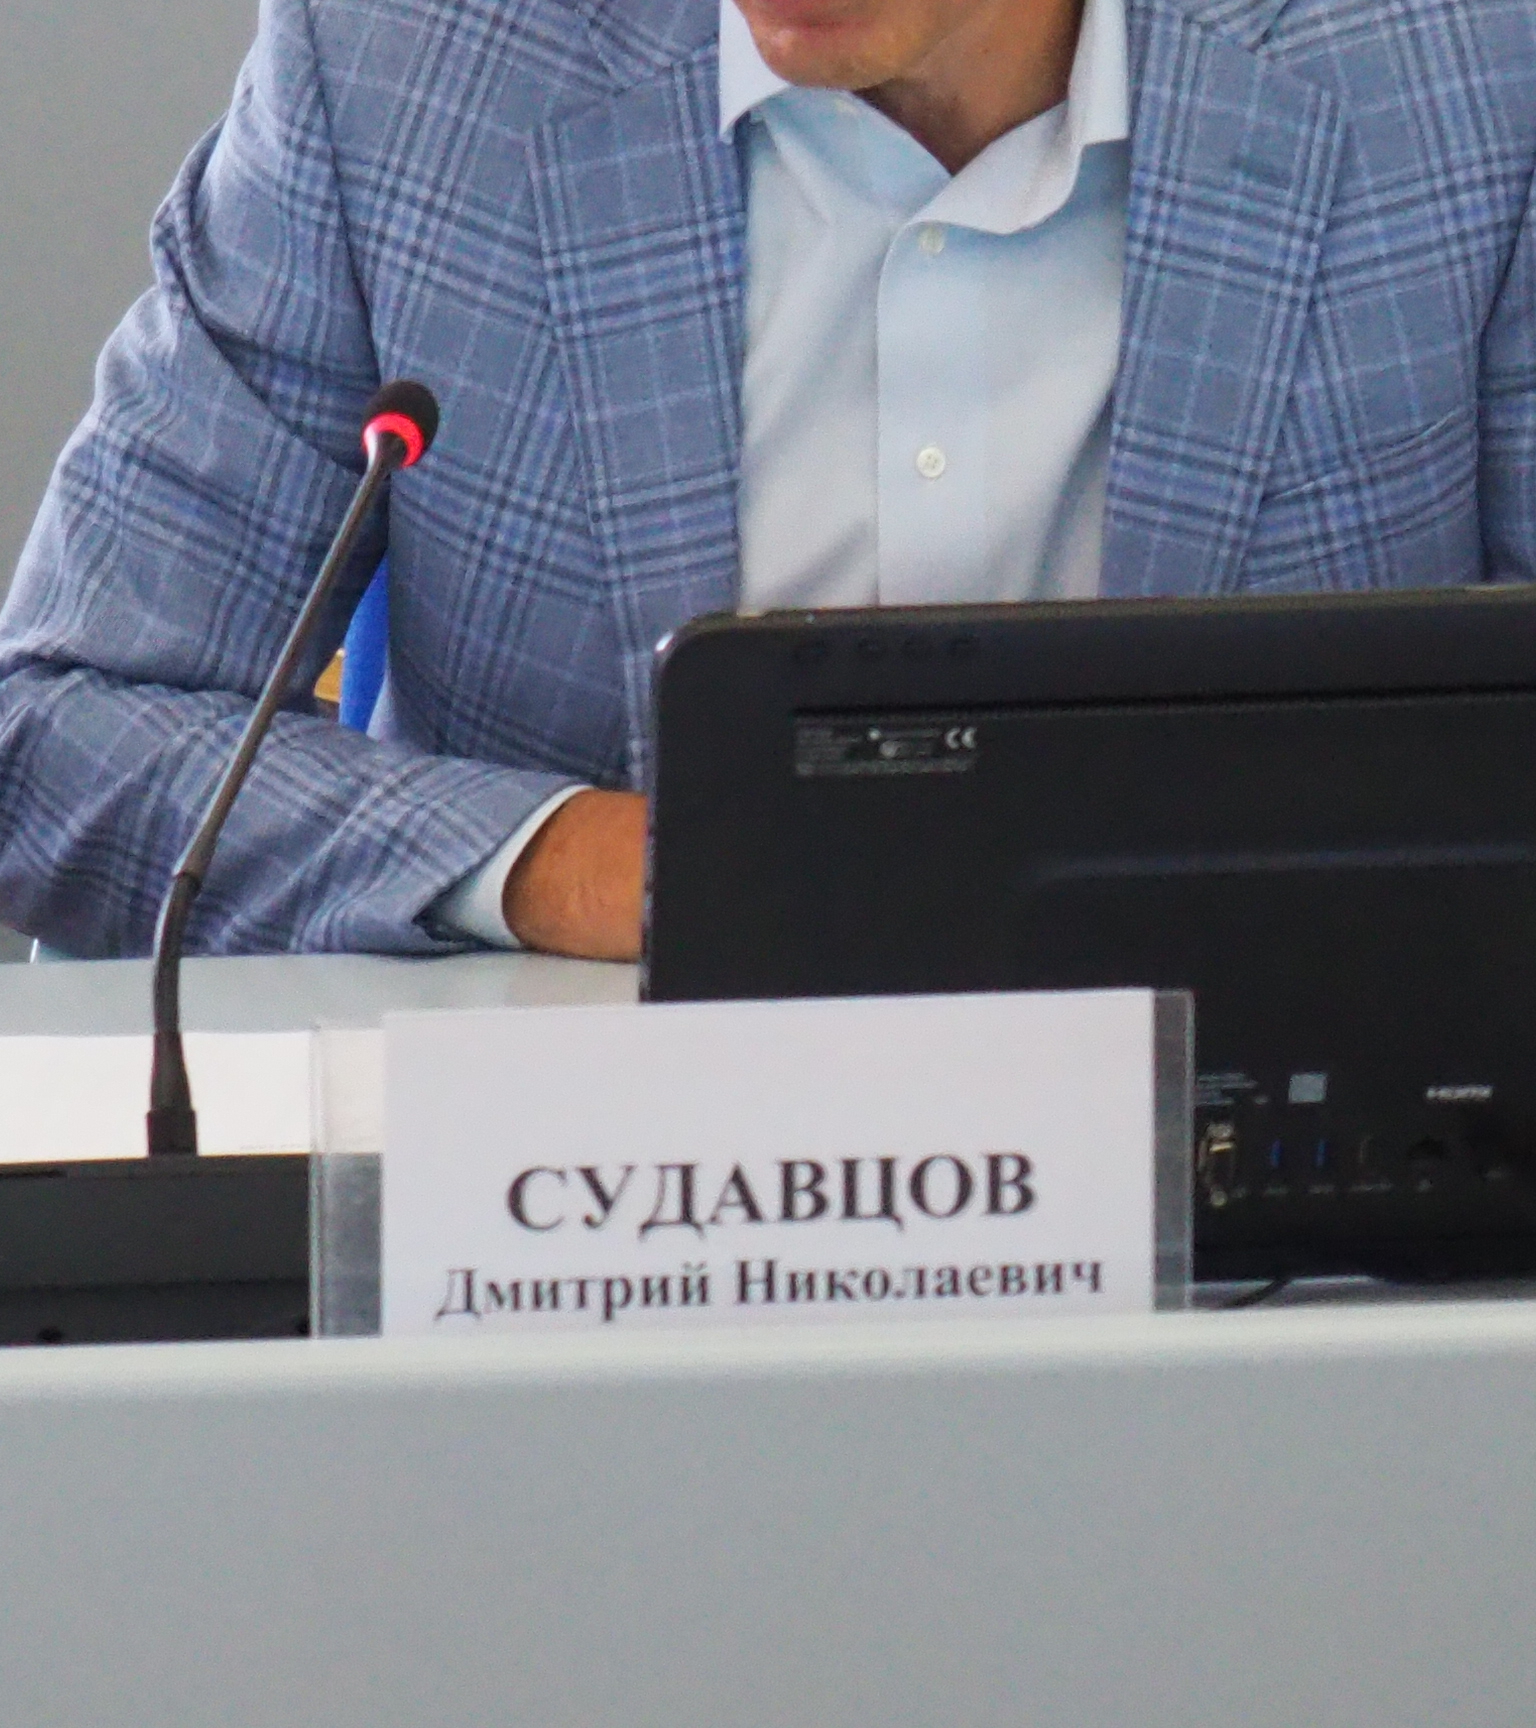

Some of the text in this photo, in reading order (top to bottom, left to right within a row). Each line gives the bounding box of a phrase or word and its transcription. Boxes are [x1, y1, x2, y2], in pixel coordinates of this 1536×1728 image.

[505, 1151, 1038, 1240] СУДАВЦОВ
[434, 1256, 1106, 1325] Дмитрий Николаевич
